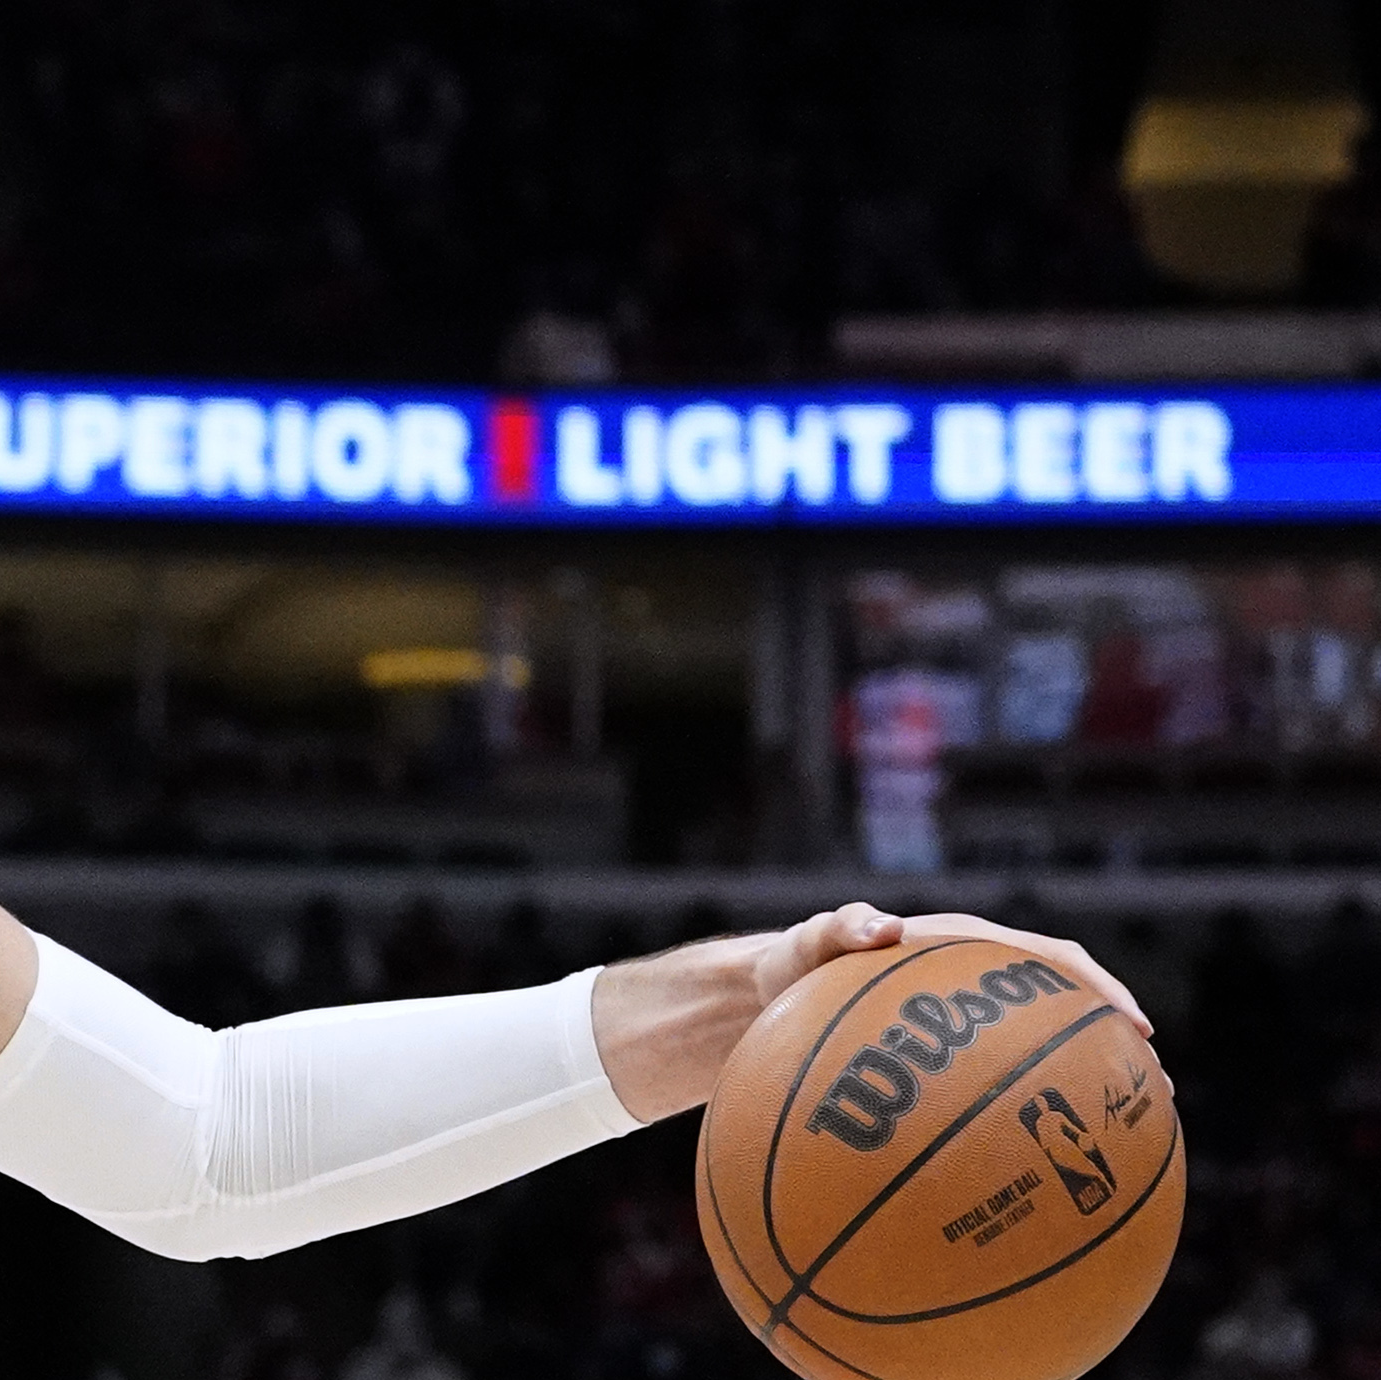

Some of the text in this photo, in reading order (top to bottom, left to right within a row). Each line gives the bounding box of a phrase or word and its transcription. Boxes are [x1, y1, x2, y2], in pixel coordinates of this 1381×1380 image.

[557, 402, 1233, 507] LIGHT BEER
[805, 960, 1080, 1151] Wilson
[942, 1169, 1044, 1244] OFFICIAL GAME BALL
